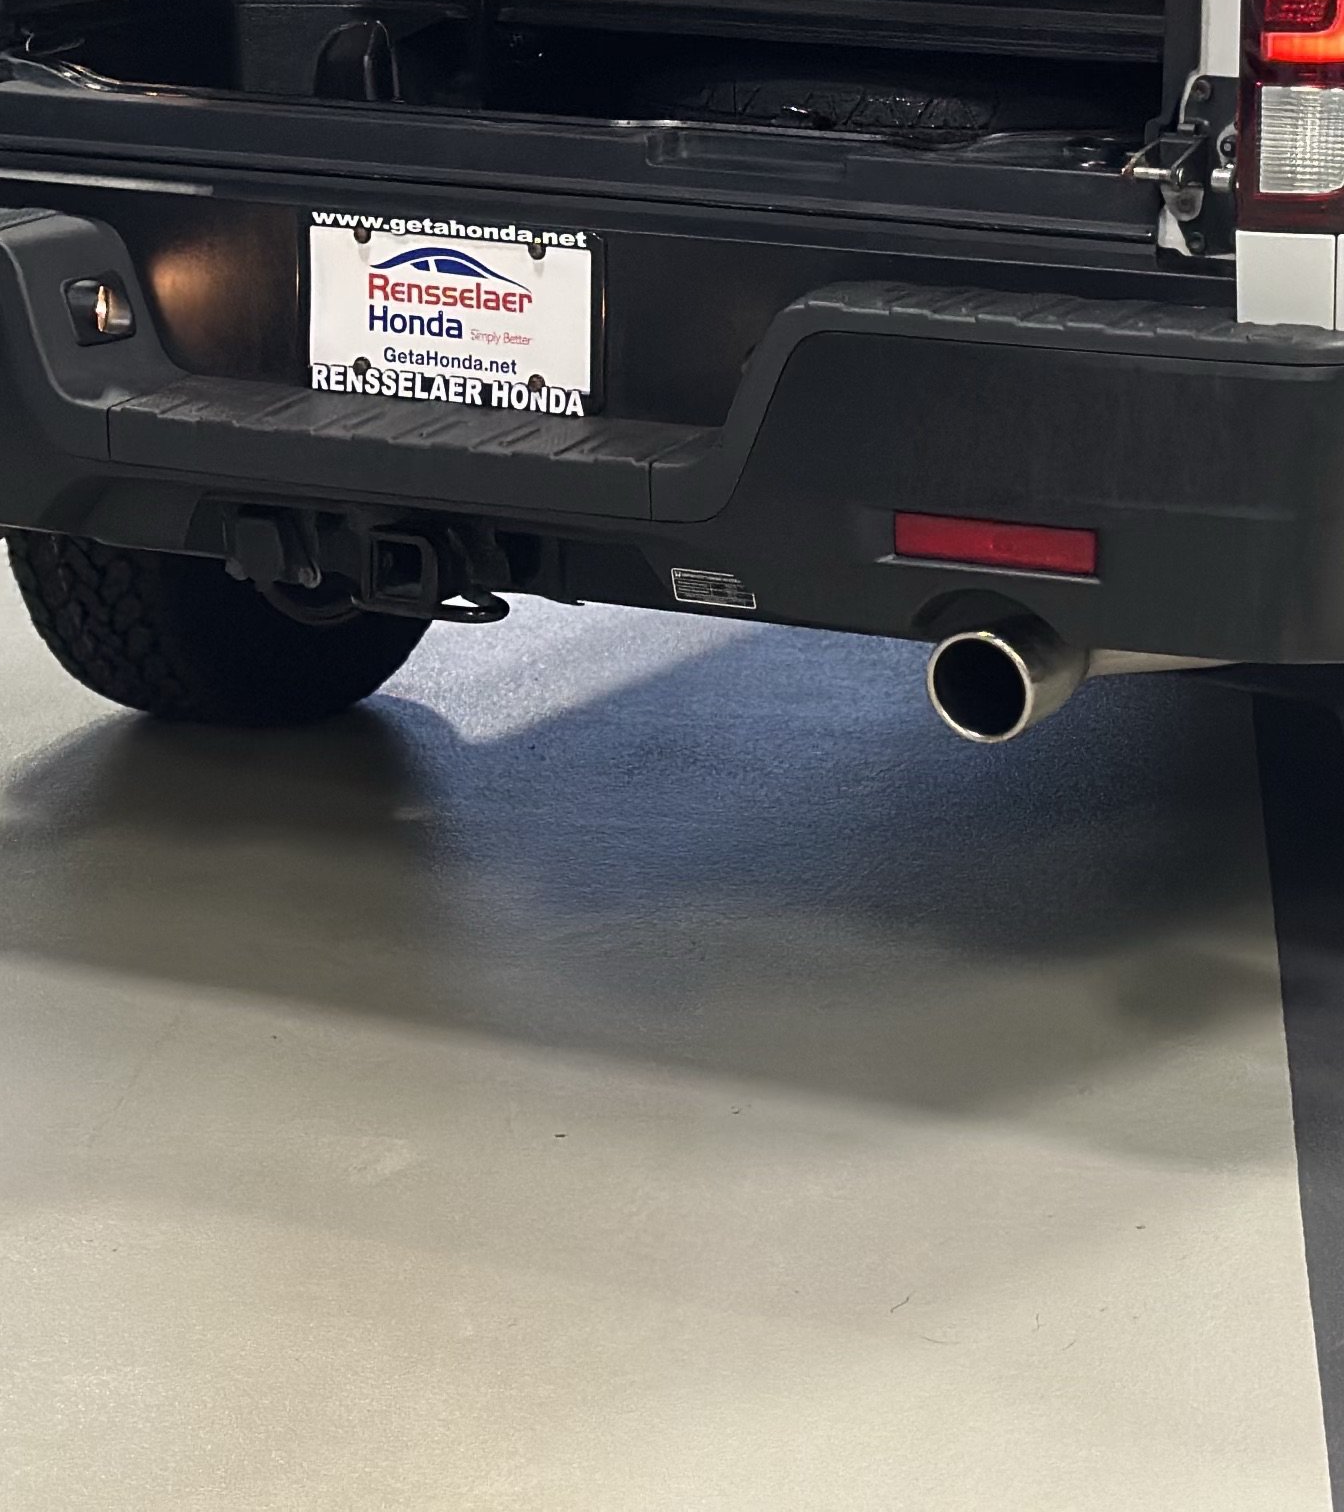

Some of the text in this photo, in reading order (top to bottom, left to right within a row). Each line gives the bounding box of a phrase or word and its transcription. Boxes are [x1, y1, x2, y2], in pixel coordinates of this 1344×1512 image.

[311, 211, 587, 248] www.getahonda.net
[368, 273, 533, 313] Rensselaer
[368, 305, 463, 339] Honda
[470, 328, 533, 346] Simply Better
[383, 346, 517, 375] GetaHonda.net
[311, 363, 585, 417] RENSSELAER HONDA
